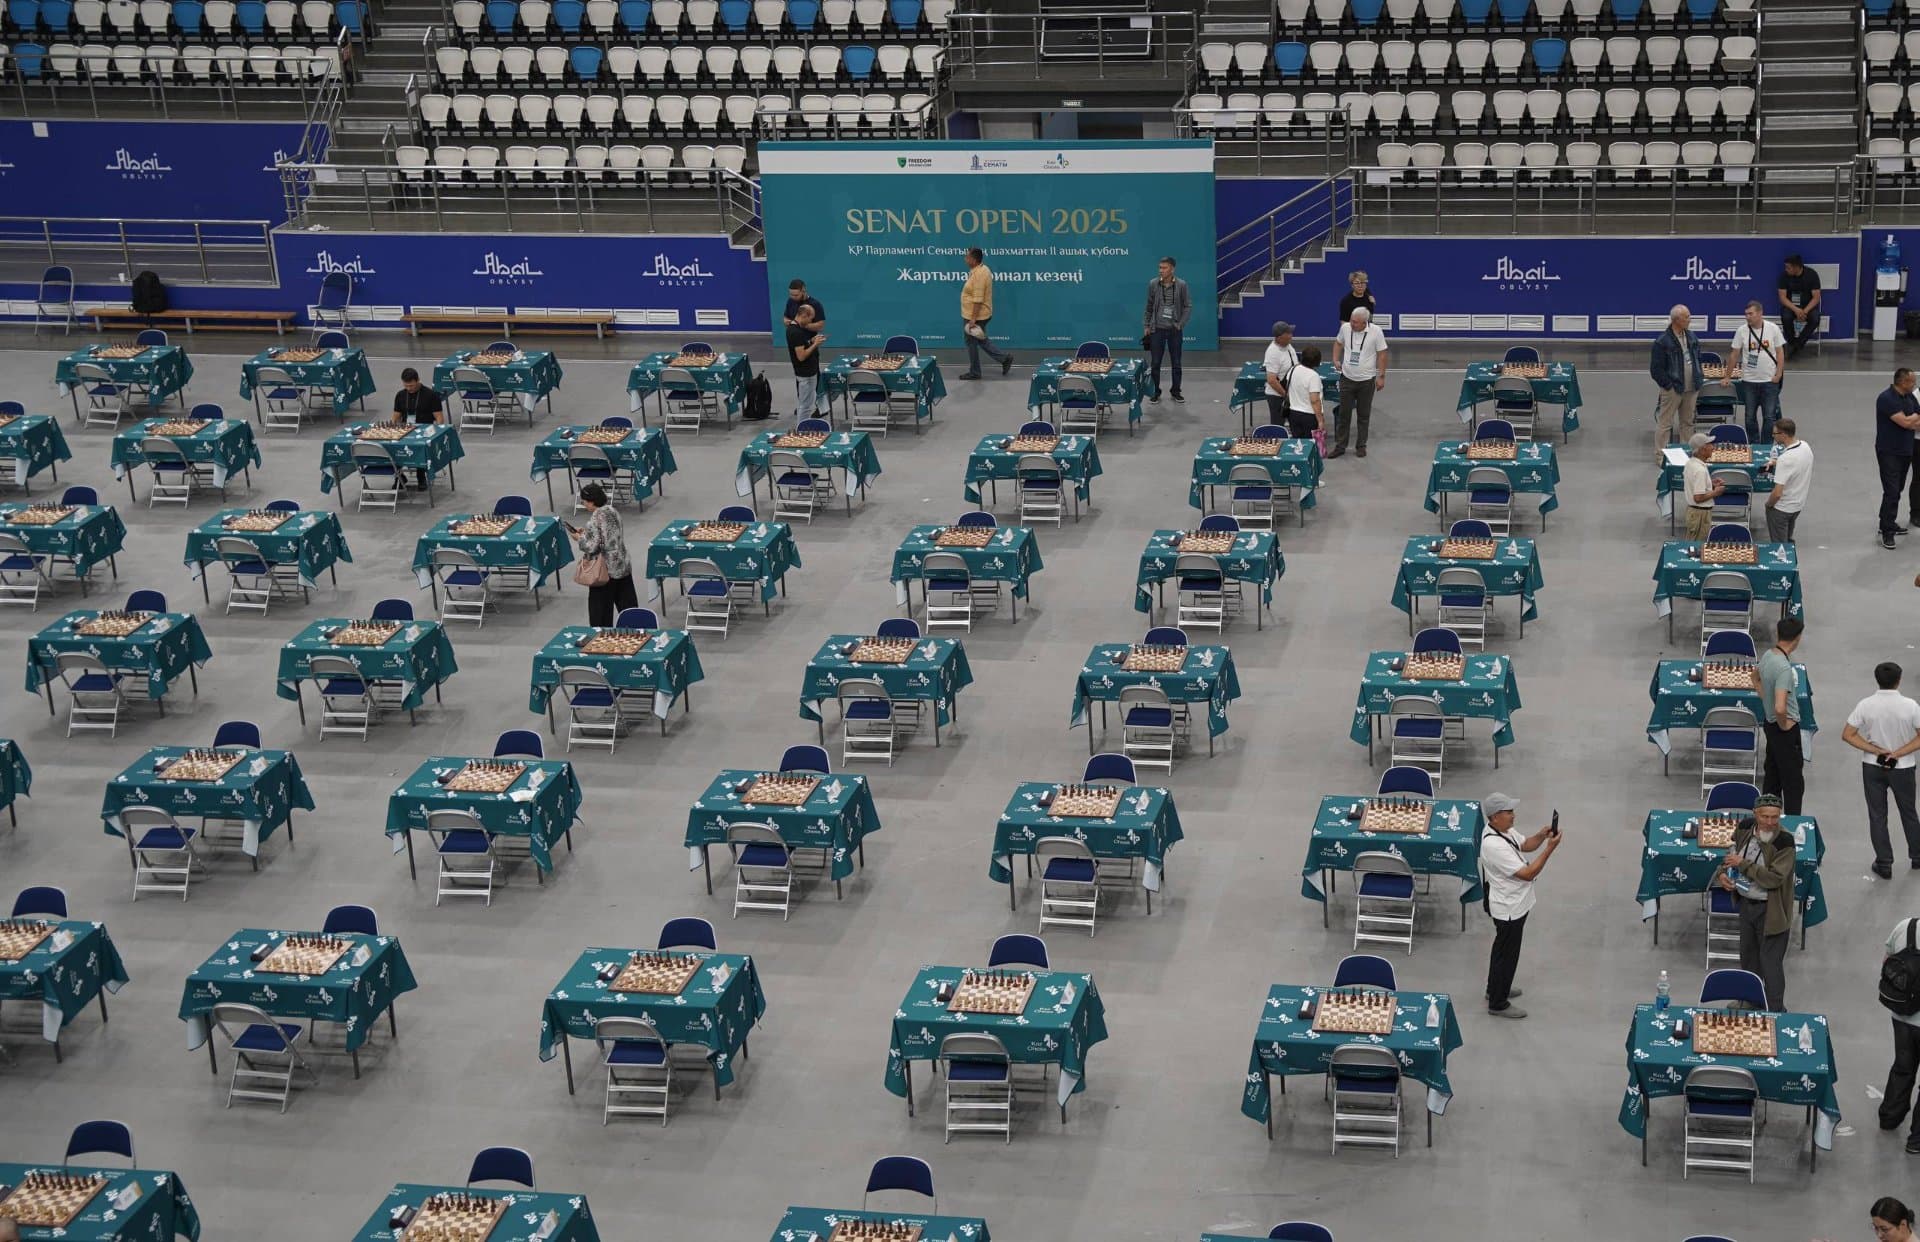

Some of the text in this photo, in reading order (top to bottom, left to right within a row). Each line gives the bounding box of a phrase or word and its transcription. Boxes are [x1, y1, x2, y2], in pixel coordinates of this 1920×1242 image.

[846, 208, 1128, 234] SENAT OPEN 2025
[848, 245, 863, 257] ҚР
[865, 245, 925, 257] Парламенті
[927, 245, 988, 257] Сенатың
[990, 247, 1047, 256] шахматтан
[1059, 247, 1089, 257] ашық
[1091, 246, 1129, 259] кубогы
[896, 267, 973, 284] Жартыла
[1035, 268, 1083, 285] кезеңі
